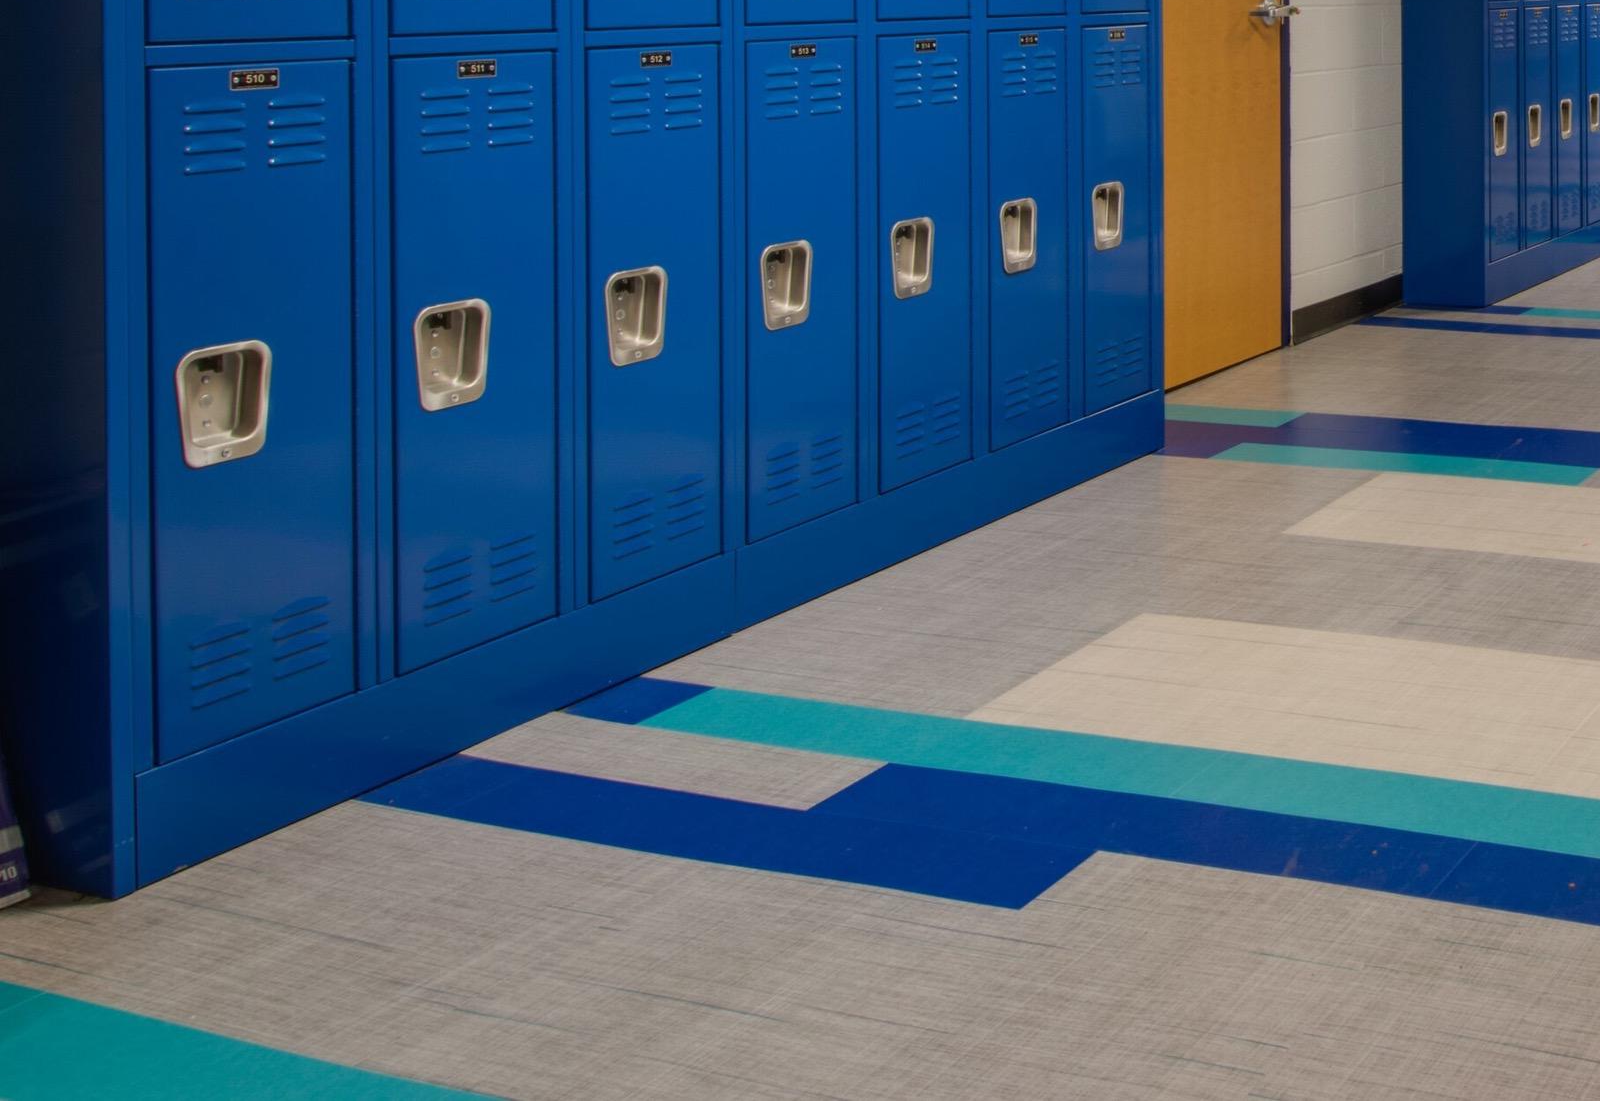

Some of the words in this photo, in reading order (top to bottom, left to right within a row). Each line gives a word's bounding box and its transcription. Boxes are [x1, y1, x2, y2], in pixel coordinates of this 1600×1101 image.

[650, 55, 663, 63] 512
[470, 64, 485, 73] 511
[246, 74, 264, 83] 510
[0, 866, 17, 882] 10
